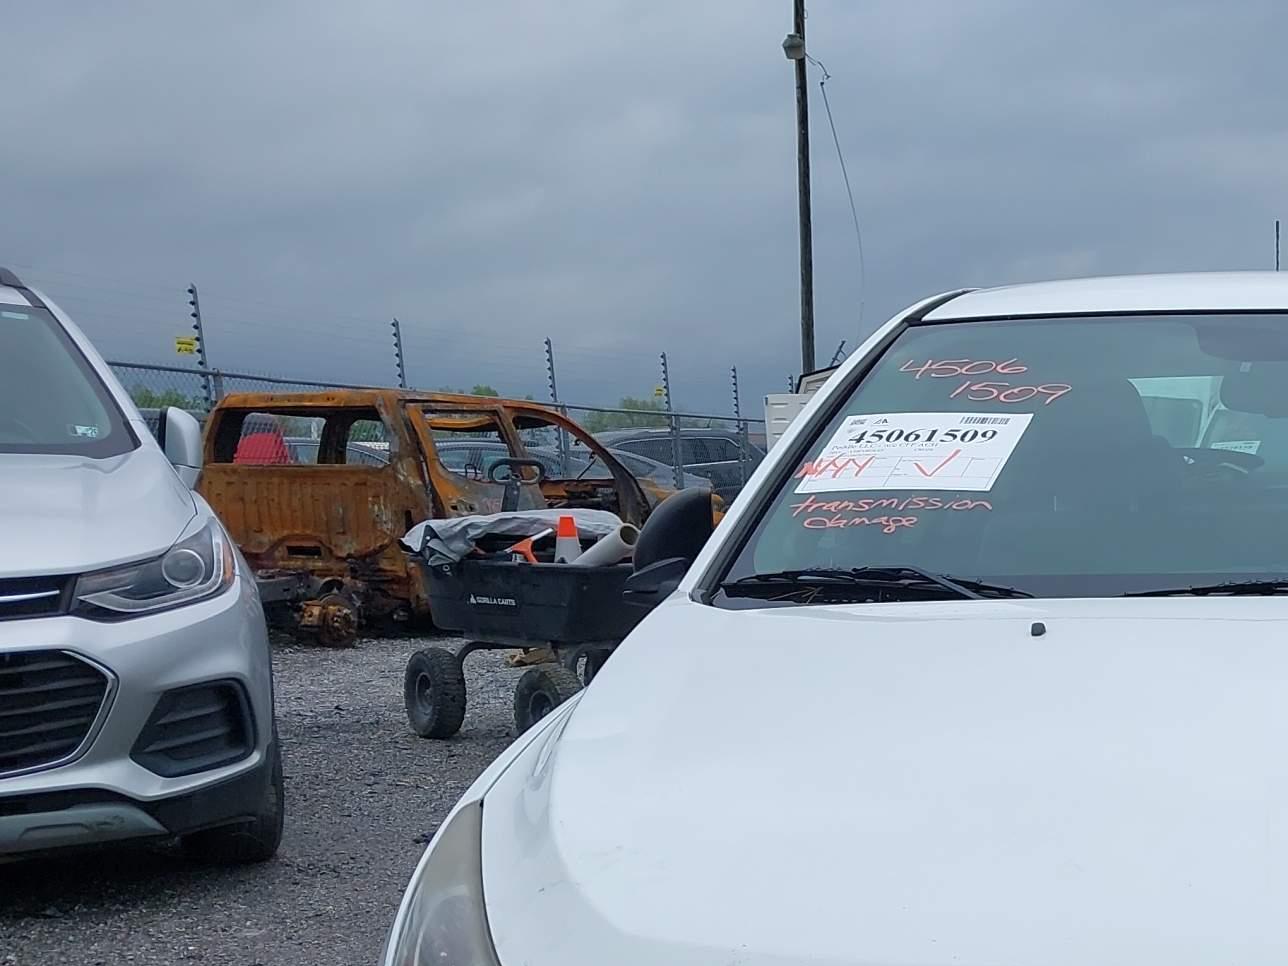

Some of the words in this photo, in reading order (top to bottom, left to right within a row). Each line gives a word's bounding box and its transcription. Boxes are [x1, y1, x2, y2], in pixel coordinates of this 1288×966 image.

[899, 358, 1028, 380] 4506
[950, 381, 1073, 405] 1509
[848, 428, 999, 444] 45061509
[789, 495, 993, 517] transmission
